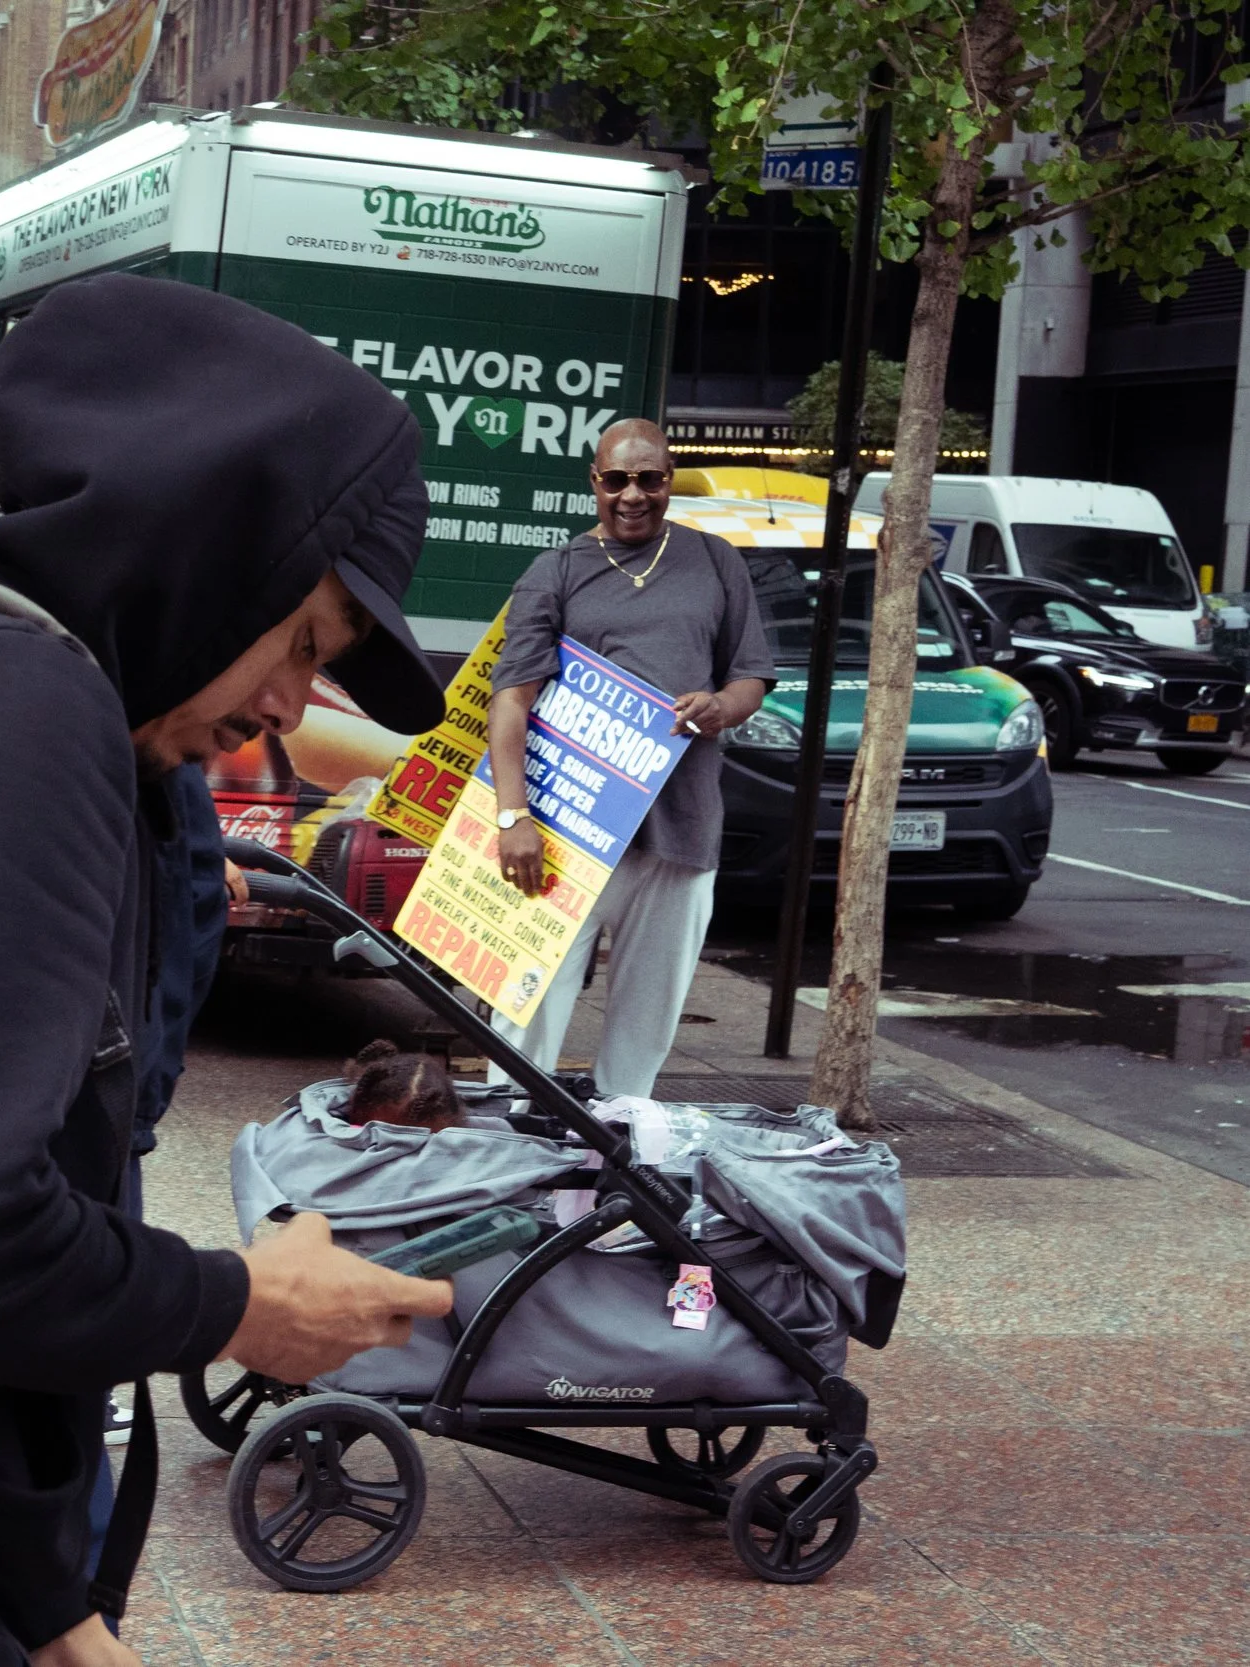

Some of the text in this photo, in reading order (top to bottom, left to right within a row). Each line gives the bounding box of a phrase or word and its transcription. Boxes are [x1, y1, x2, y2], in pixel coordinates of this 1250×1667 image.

[767, 160, 856, 183] 104185
[13, 220, 33, 252] THE
[33, 201, 77, 245] FLAVOR
[80, 192, 97, 226] OF
[98, 177, 132, 219] NEW
[363, 185, 540, 240] Nathan's
[286, 235, 599, 277] OPERATED BY Y2J 718-728-1530 INFO@Y2JNYC.COM
[352, 338, 624, 399] FLAVOR OF
[666, 424, 697, 438] AND
[704, 425, 765, 439] MIRIAM
[453, 483, 501, 508] RINGS
[531, 490, 564, 513] HOT
[464, 519, 498, 544] DOG
[500, 522, 570, 549] NUGGETS
[460, 683, 493, 713] FIN
[564, 660, 660, 729] COHEN
[530, 678, 671, 783] ARBERSHOP
[418, 736, 477, 775] JEWEL
[525, 729, 608, 794] ROYAL SHAVE
[901, 769, 945, 780] AM
[390, 753, 468, 818] RE
[551, 775, 596, 815] TAPER
[401, 813, 439, 839] WEST
[453, 811, 489, 851] WE
[555, 803, 616, 853] HAIRCUT
[384, 847, 431, 858] HOND
[439, 868, 547, 952] FINE WATCHES COINS
[440, 843, 467, 869] GOLD
[472, 866, 526, 911] DIAMONDS
[531, 907, 567, 939] SILVER
[538, 872, 589, 922] SELL
[420, 887, 519, 963] JEWELRY & WATCH
[402, 900, 509, 1000] REPAIR
[548, 1380, 655, 1399] NAVIGATOR
